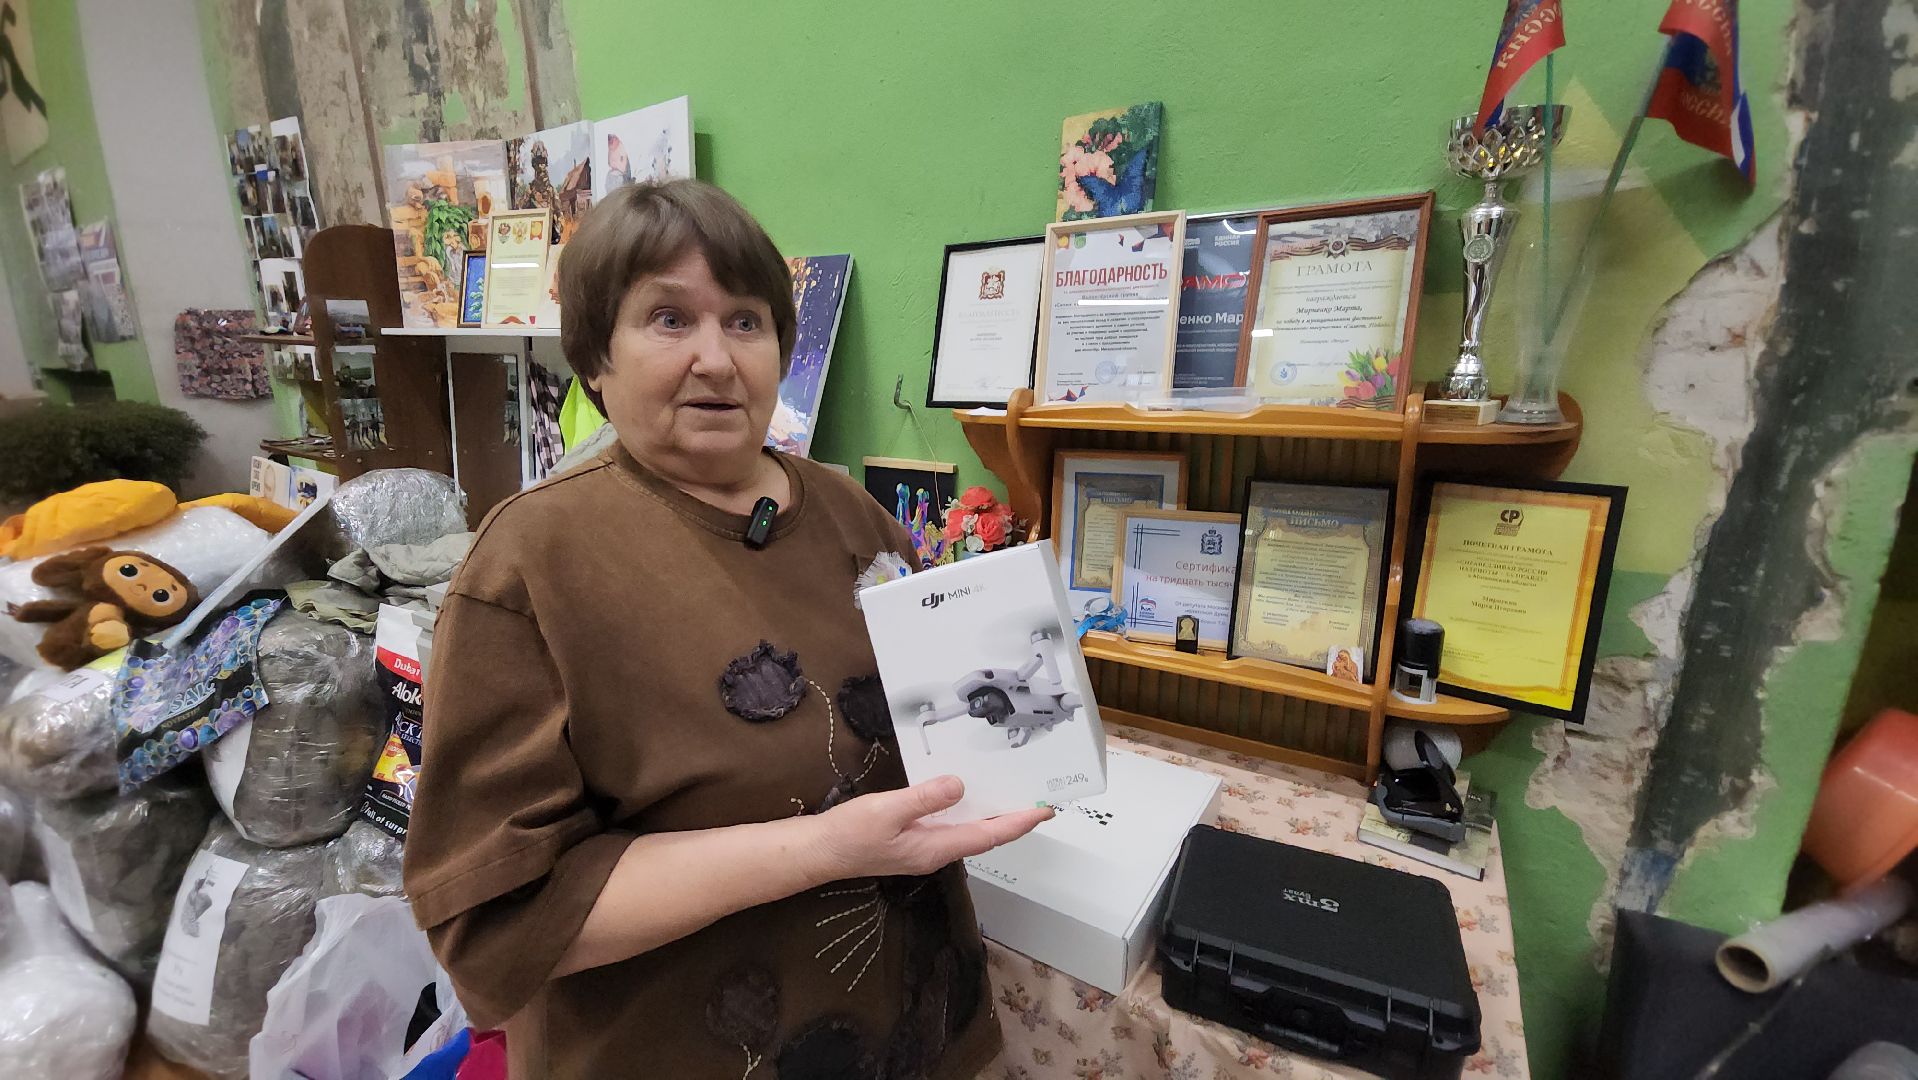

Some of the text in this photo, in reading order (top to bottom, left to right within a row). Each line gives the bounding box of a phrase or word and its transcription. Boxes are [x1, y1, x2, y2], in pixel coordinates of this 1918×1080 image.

[1055, 262, 1168, 288] БЛАГОДАРНОСТЬ
[1297, 260, 1374, 277] ГРАМОТА
[1500, 509, 1521, 523] СР
[1175, 560, 1236, 575] Сертифика
[1159, 575, 1204, 587] тридцать
[947, 585, 971, 600] MINI
[375, 816, 386, 825] of
